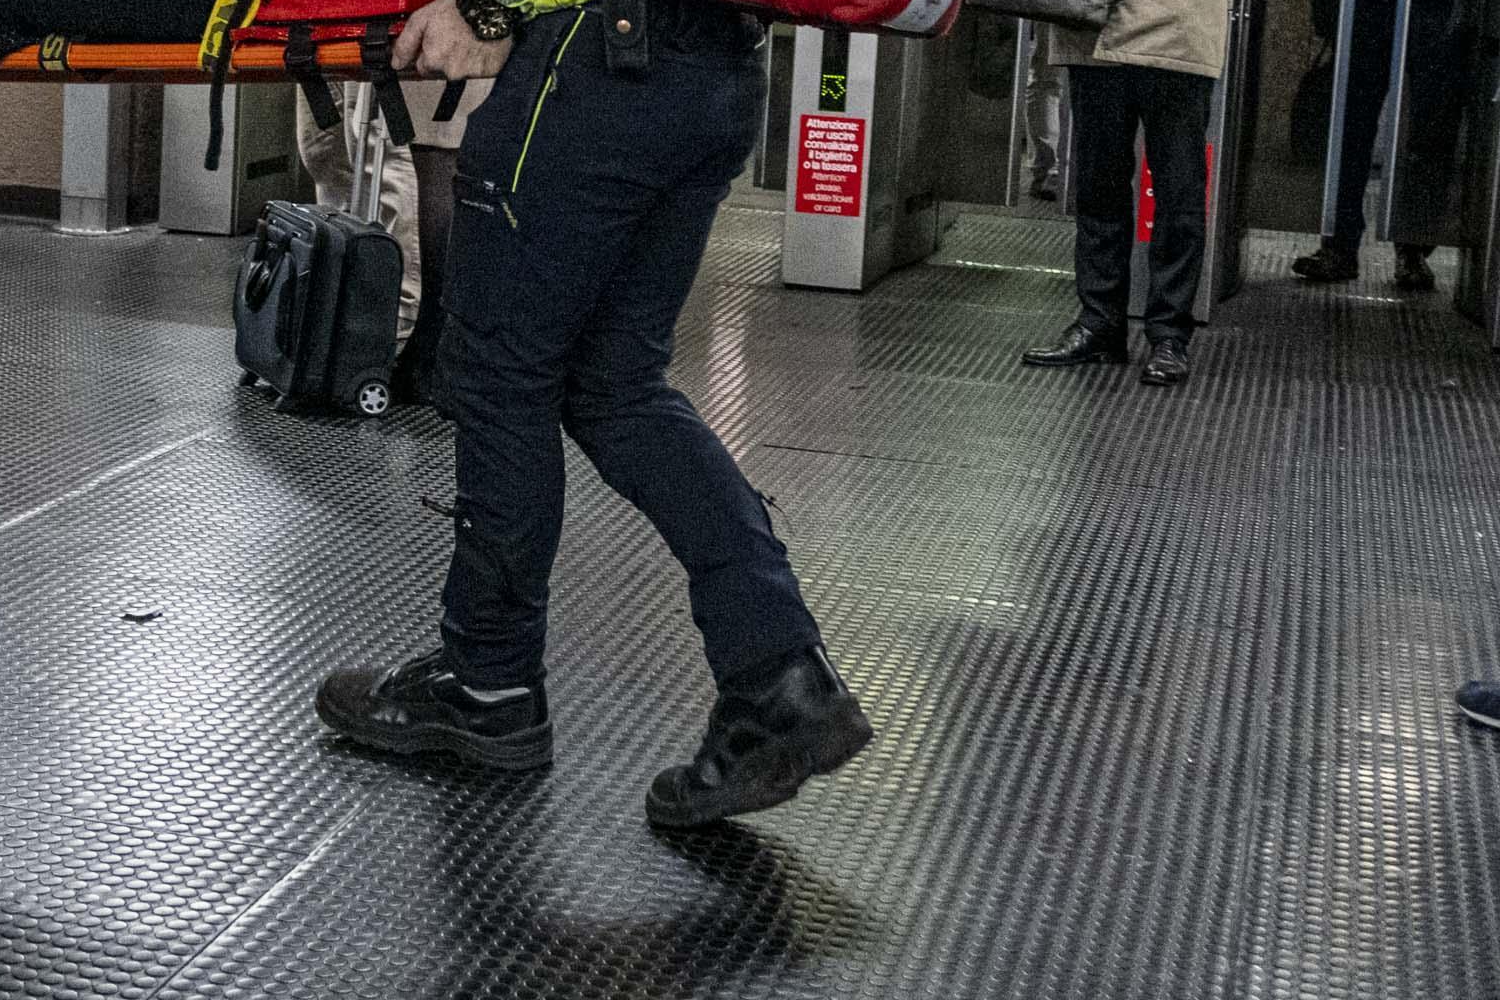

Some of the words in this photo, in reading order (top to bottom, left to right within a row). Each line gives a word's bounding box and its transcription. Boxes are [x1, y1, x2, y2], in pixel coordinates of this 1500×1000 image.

[806, 118, 860, 131] Attenzione:
[808, 130, 825, 140] per
[826, 131, 856, 141] uscire
[804, 140, 859, 152] convalidare
[815, 150, 853, 162] biglietto
[803, 161, 811, 169] o
[821, 161, 857, 173] tessera
